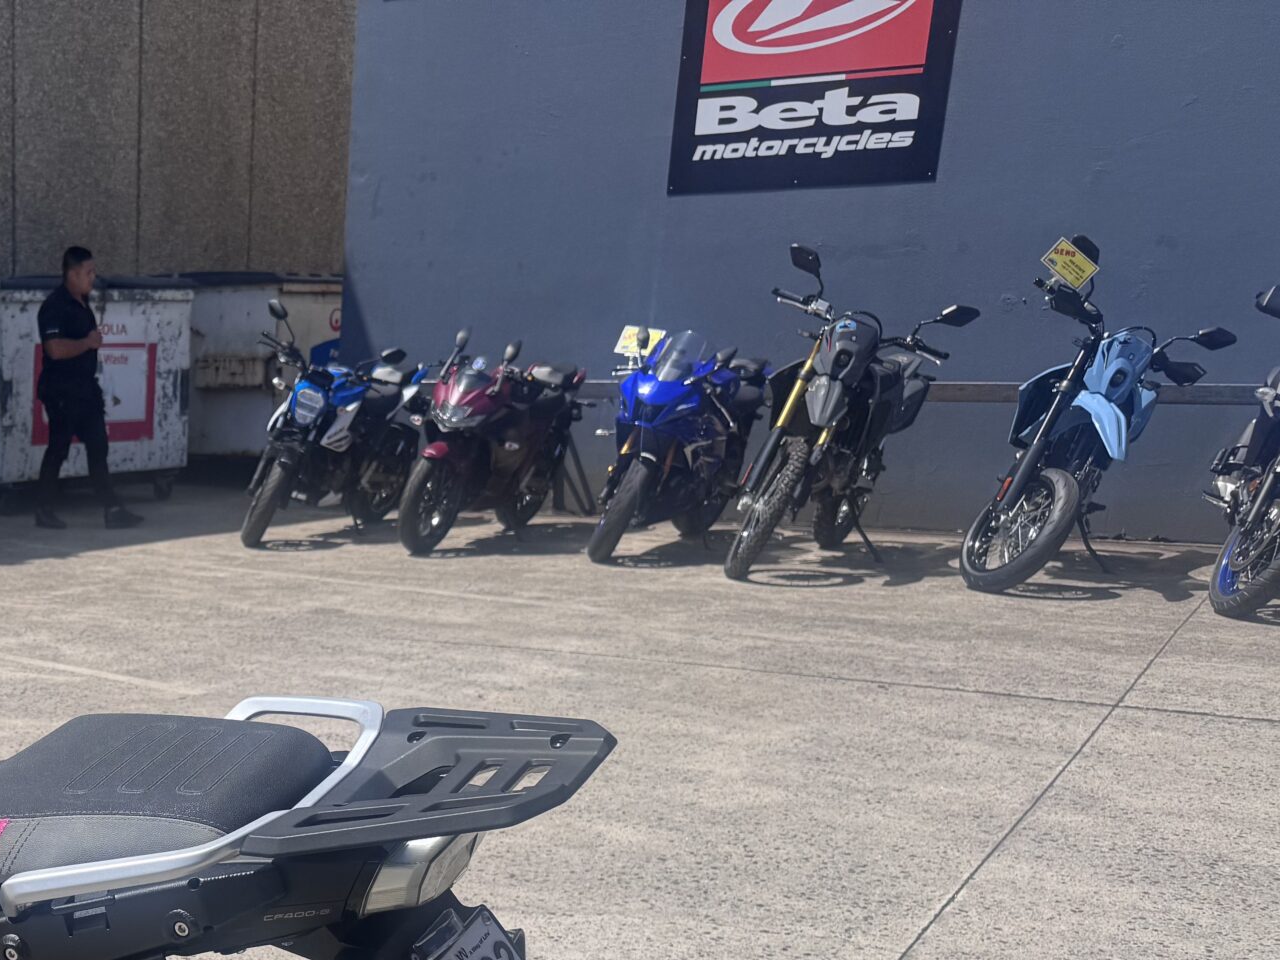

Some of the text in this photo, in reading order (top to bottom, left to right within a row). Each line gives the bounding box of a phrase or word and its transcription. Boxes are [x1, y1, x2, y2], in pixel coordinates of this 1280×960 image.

[694, 86, 920, 136] Beta
[692, 129, 916, 161] motorcycles
[100, 324, 128, 336] OLIA
